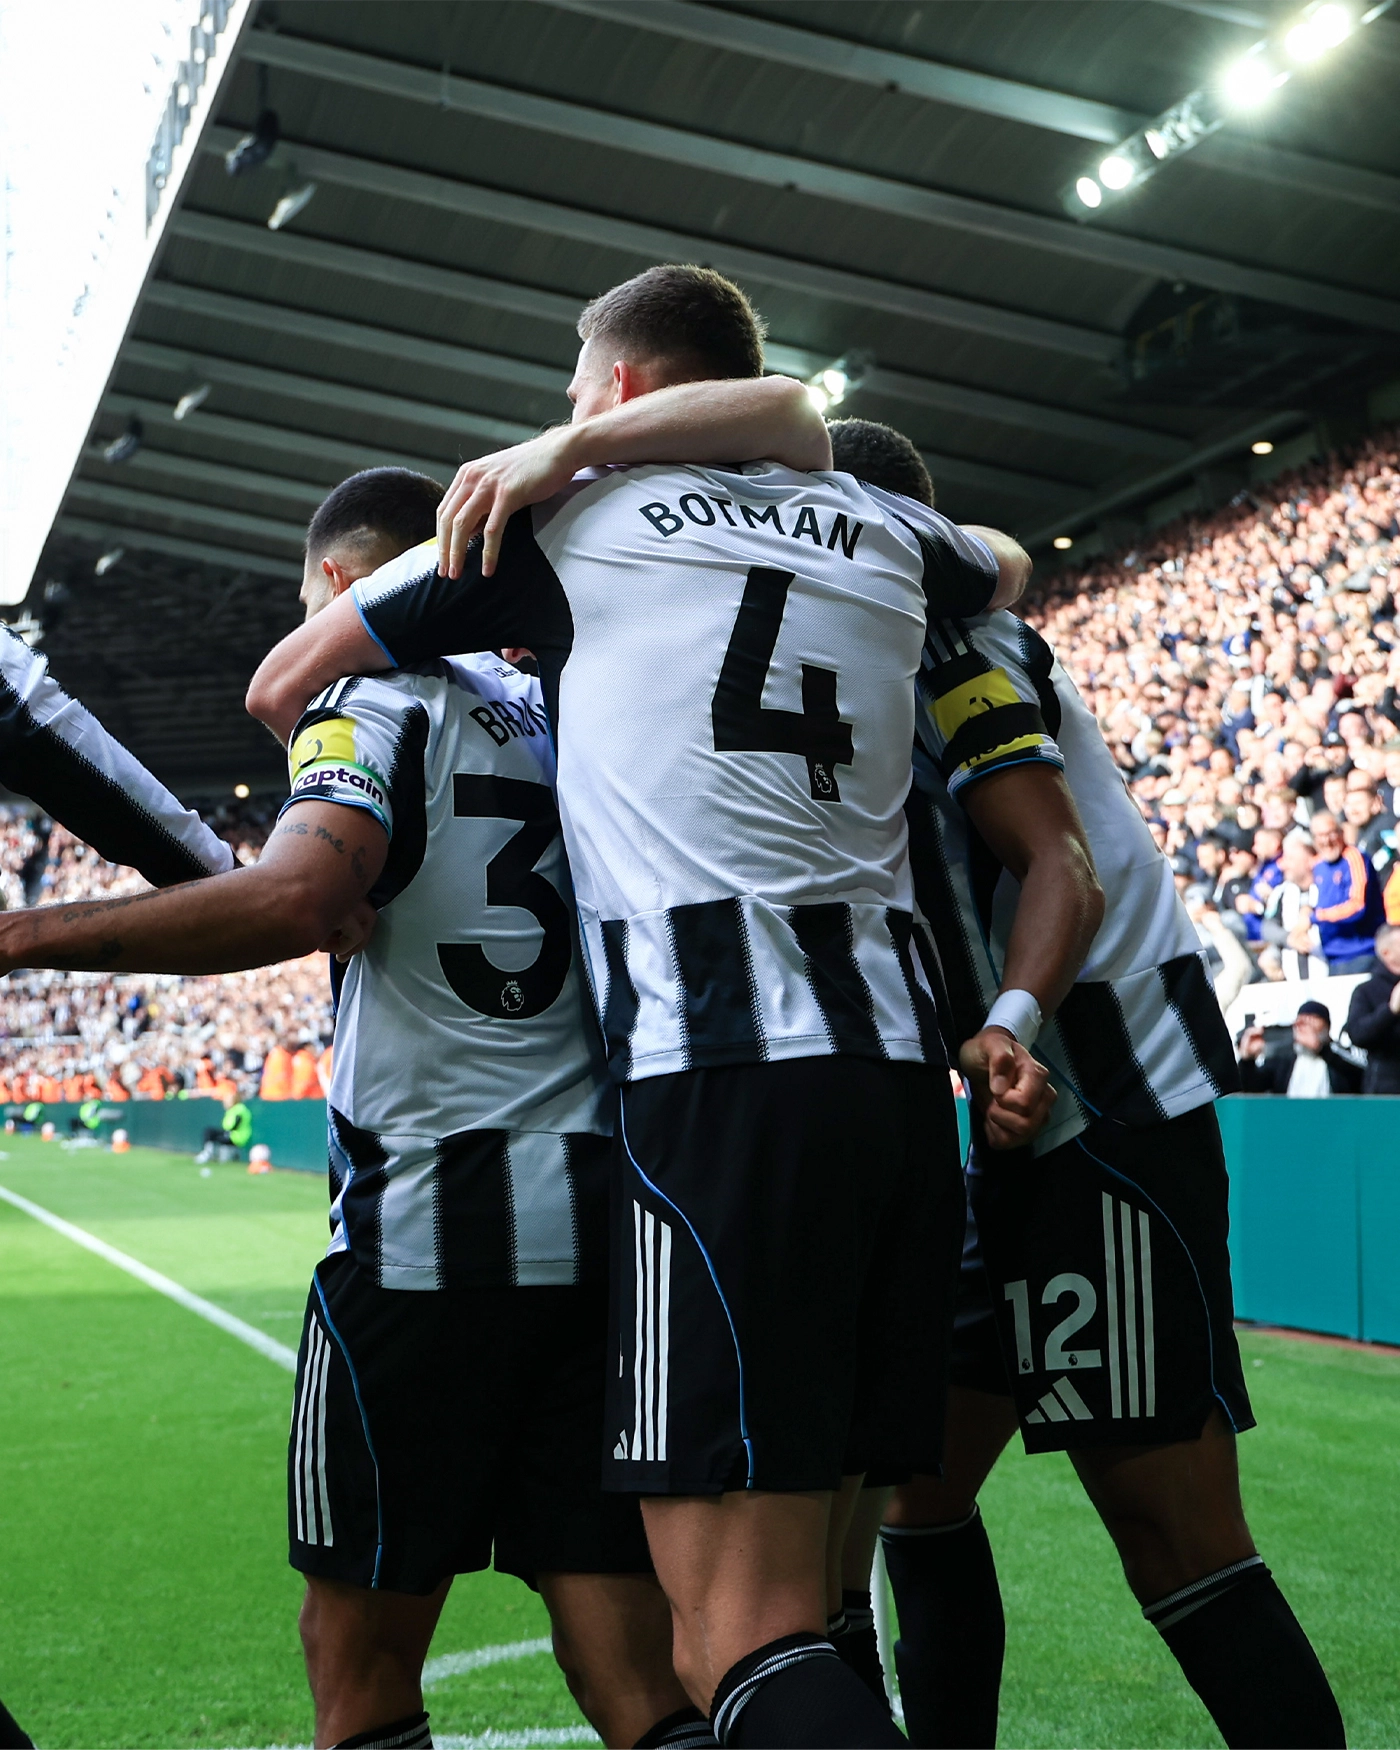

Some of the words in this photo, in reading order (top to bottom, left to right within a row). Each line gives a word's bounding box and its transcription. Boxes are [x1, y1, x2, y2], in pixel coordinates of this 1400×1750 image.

[638, 493, 864, 561] BOTMAN
[711, 566, 855, 804] 4
[294, 768, 384, 806] captain
[435, 772, 573, 1021] 3
[1004, 1272, 1103, 1375] 12
